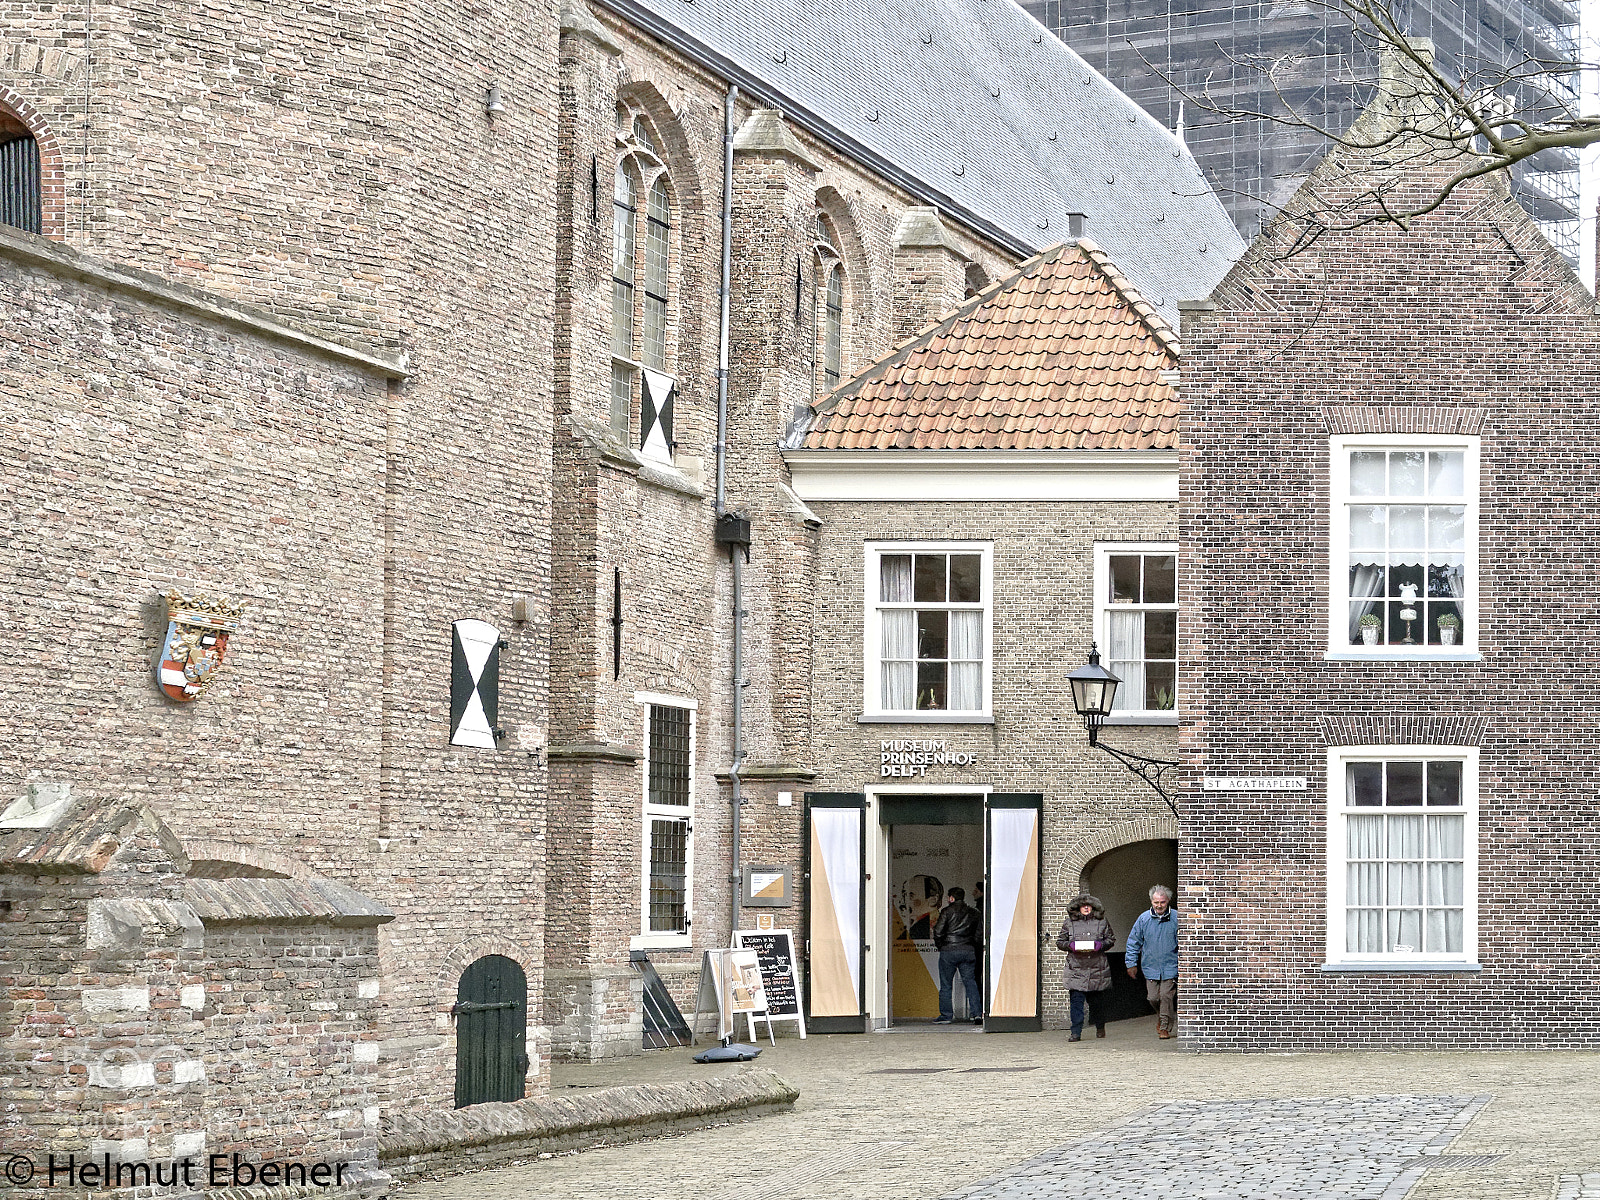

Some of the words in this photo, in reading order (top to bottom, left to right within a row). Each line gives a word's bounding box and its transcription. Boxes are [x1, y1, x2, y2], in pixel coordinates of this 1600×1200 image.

[881, 740, 946, 752] MUSEUM
[881, 752, 978, 765] PRINSENHOF
[881, 764, 928, 777] DELFT
[1208, 780, 1221, 788] ST
[1229, 780, 1303, 788] AGATHAPLEIN
